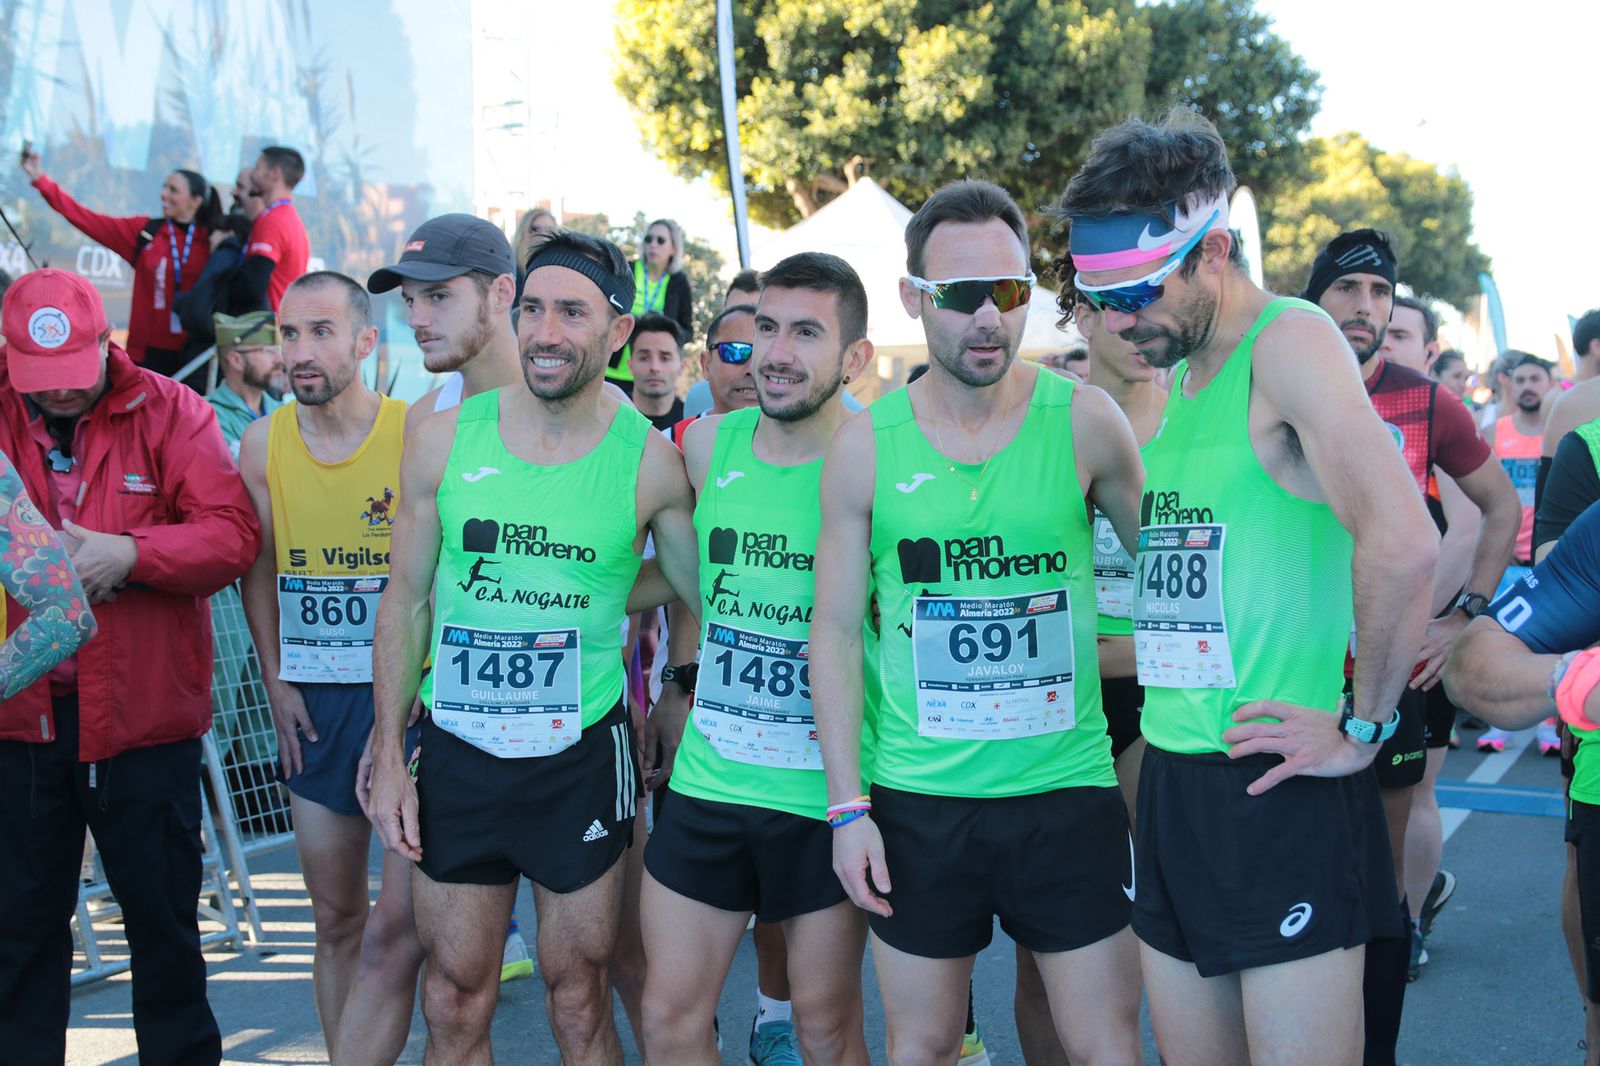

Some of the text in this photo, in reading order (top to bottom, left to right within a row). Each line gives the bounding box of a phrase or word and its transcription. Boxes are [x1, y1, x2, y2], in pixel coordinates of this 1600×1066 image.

[76, 244, 123, 280] CDX
[502, 523, 548, 543] pan
[1095, 519, 1121, 555] 5
[742, 532, 787, 554] pan
[1164, 538, 1178, 546] 2022
[505, 539, 597, 563] moreno
[944, 535, 1004, 567] pan
[952, 551, 1067, 581] moreno
[1093, 555, 1123, 565] UBIO
[1138, 553, 1207, 600] 1488
[475, 586, 590, 610] C.A. NOGALTE
[984, 600, 1015, 608] Maratón
[300, 595, 367, 626] 860
[717, 599, 813, 625] C.A. NOGAL
[959, 607, 1014, 617] Almería 2022
[1146, 602, 1180, 613] NICOLAS
[320, 628, 345, 636] SUSO
[473, 632, 523, 641] Medio Maratón
[473, 639, 522, 648] Almería 2022
[738, 640, 765, 652] Almería
[765, 645, 785, 655] 2022
[739, 633, 787, 648] Medio Maratón
[949, 618, 1039, 664] 691
[452, 650, 565, 688] 1487
[967, 664, 1025, 677] JAVALOY
[471, 689, 540, 700] GUILLAUME
[746, 695, 781, 709] JAIME
[961, 701, 976, 709] CDX
[472, 721, 486, 729] CDX
[729, 723, 742, 733] CDX
[583, 829, 609, 842] adidas
